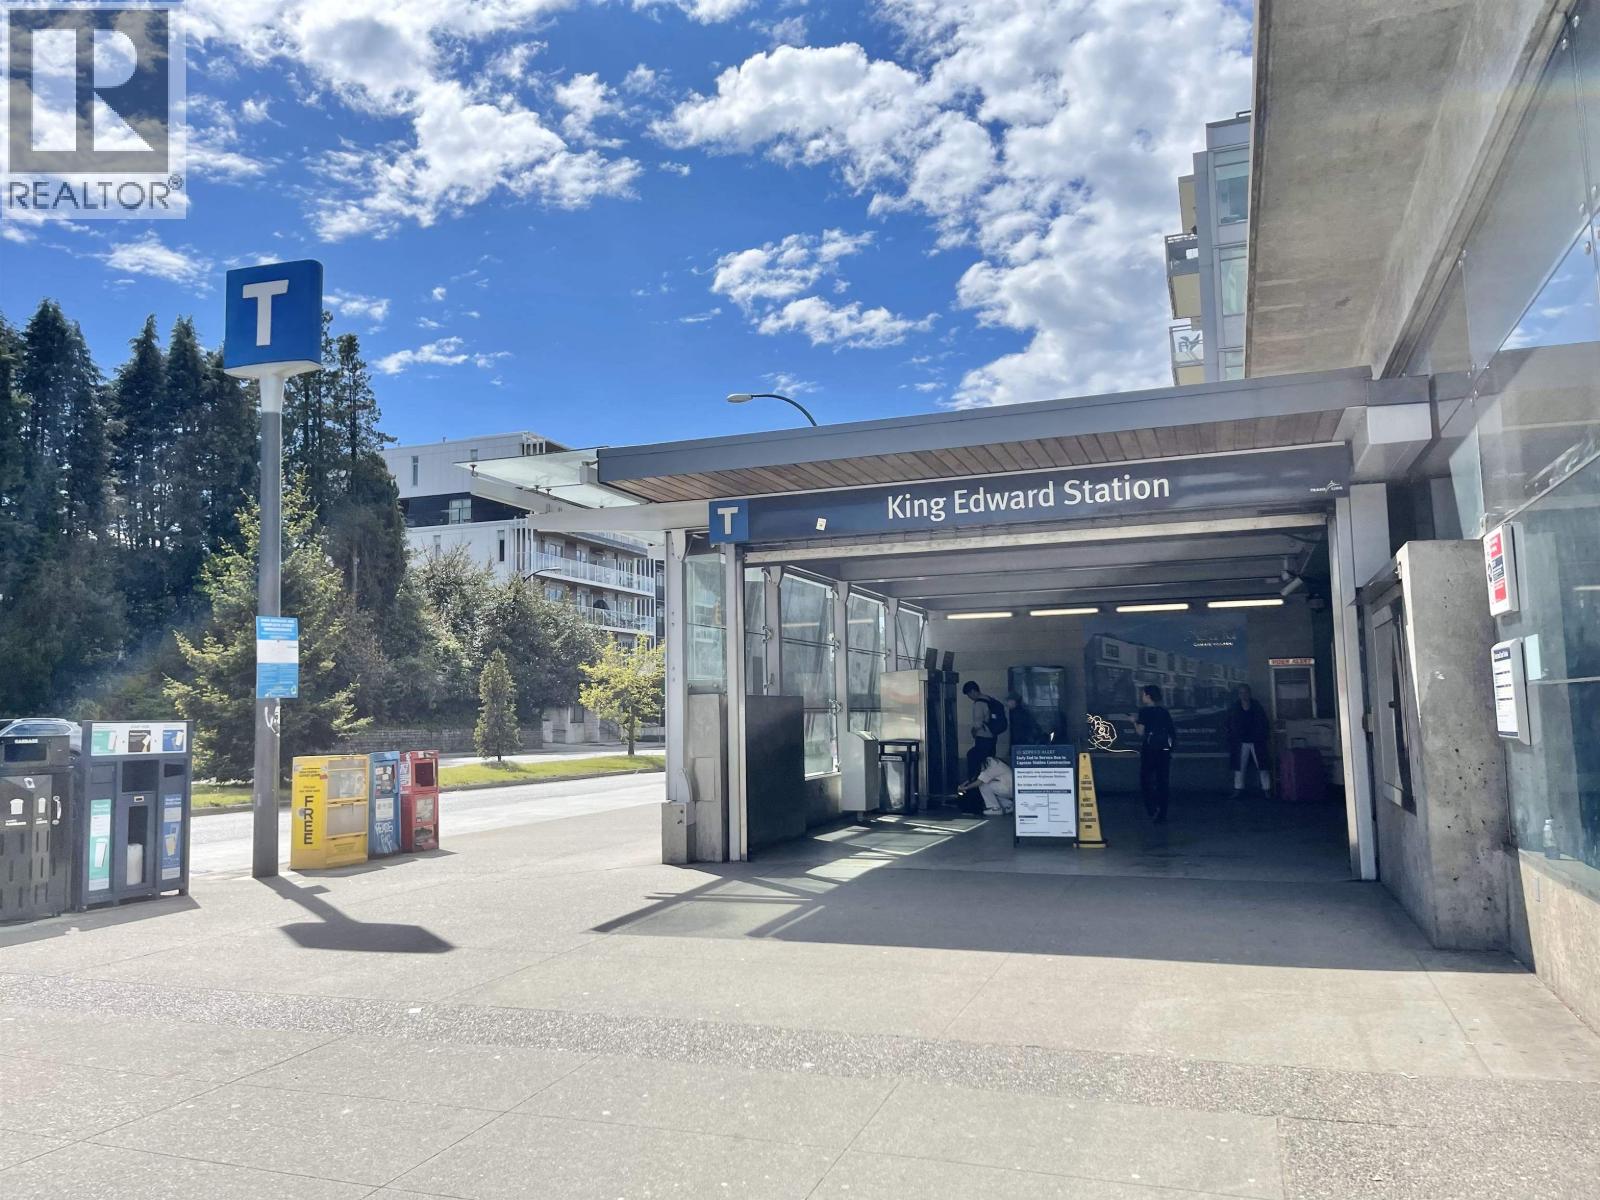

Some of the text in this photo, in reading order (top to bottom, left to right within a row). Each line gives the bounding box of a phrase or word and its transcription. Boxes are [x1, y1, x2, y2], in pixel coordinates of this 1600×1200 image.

[242, 279, 289, 347] T
[717, 506, 739, 535] T
[888, 474, 1170, 522] King Edward Station
[303, 795, 315, 845] FREE
